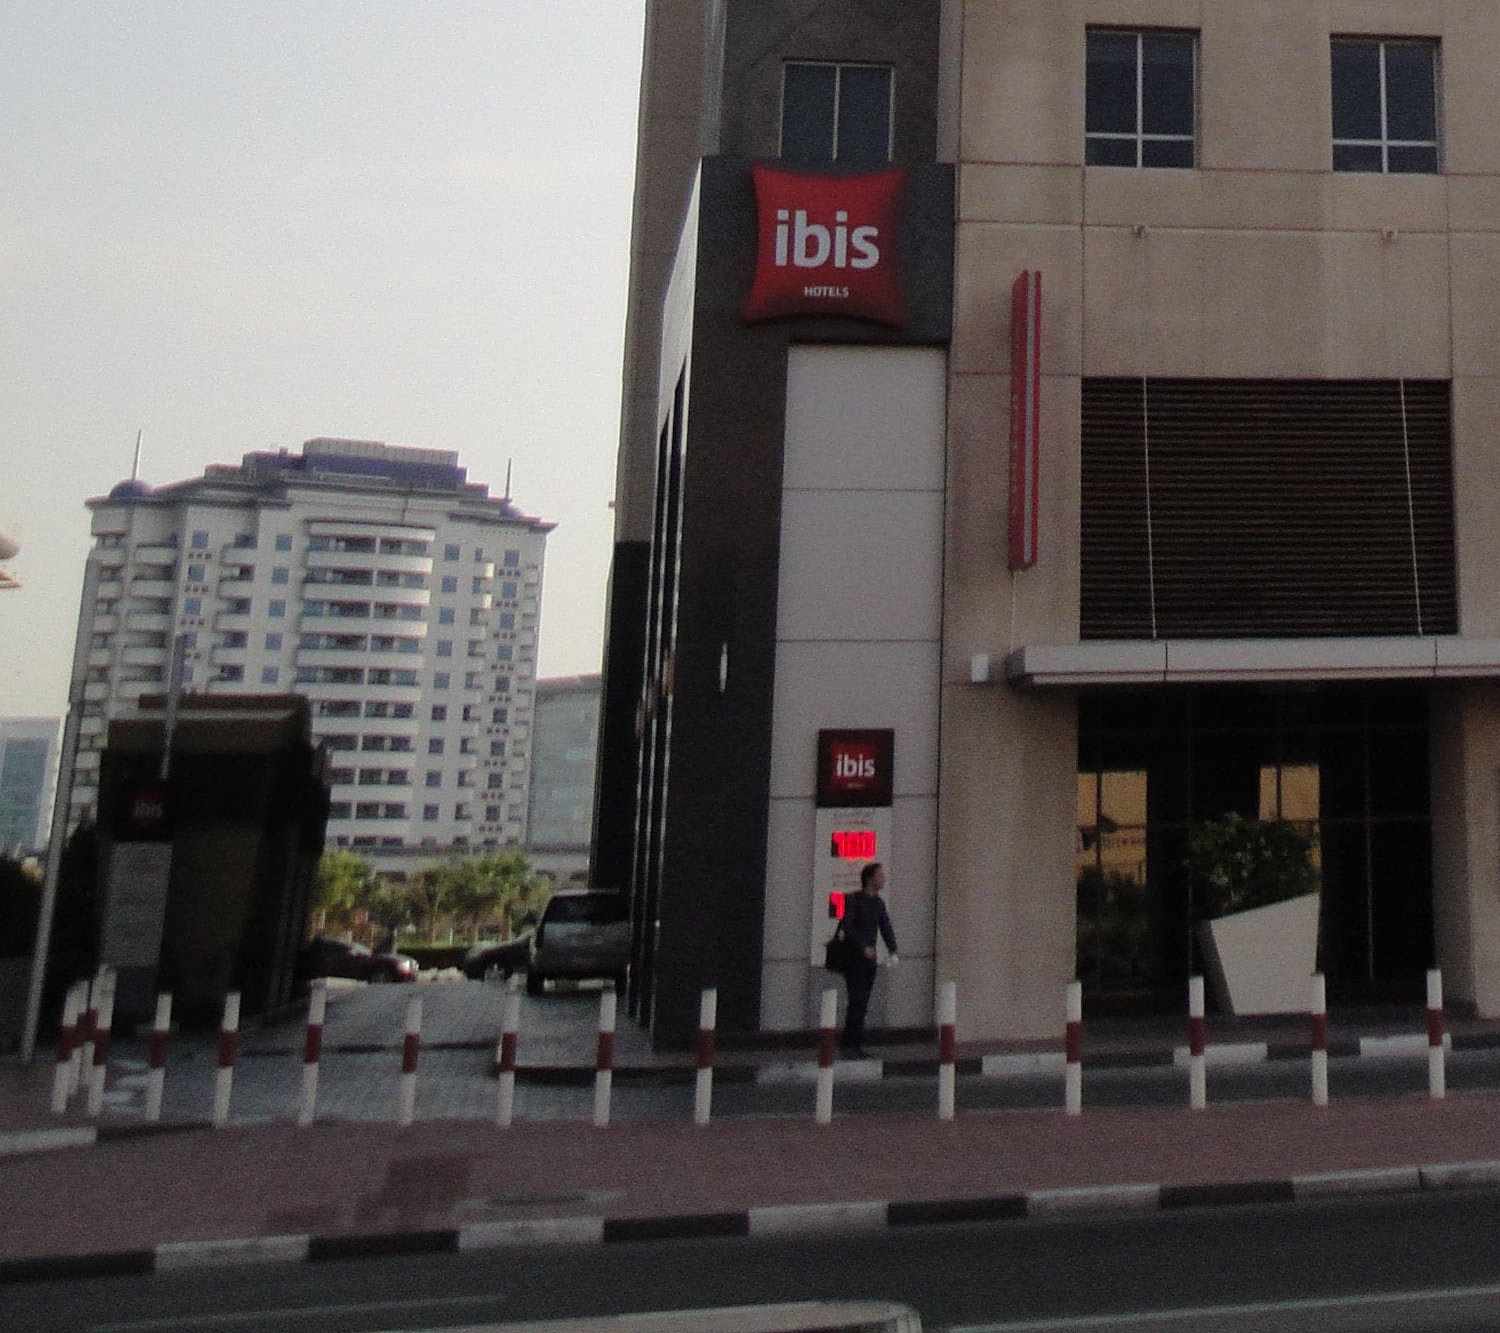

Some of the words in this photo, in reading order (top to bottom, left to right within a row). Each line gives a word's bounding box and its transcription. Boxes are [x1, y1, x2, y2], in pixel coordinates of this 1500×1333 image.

[775, 209, 880, 269] ibis
[803, 285, 849, 299] HOTELS
[836, 754, 876, 778] ibis
